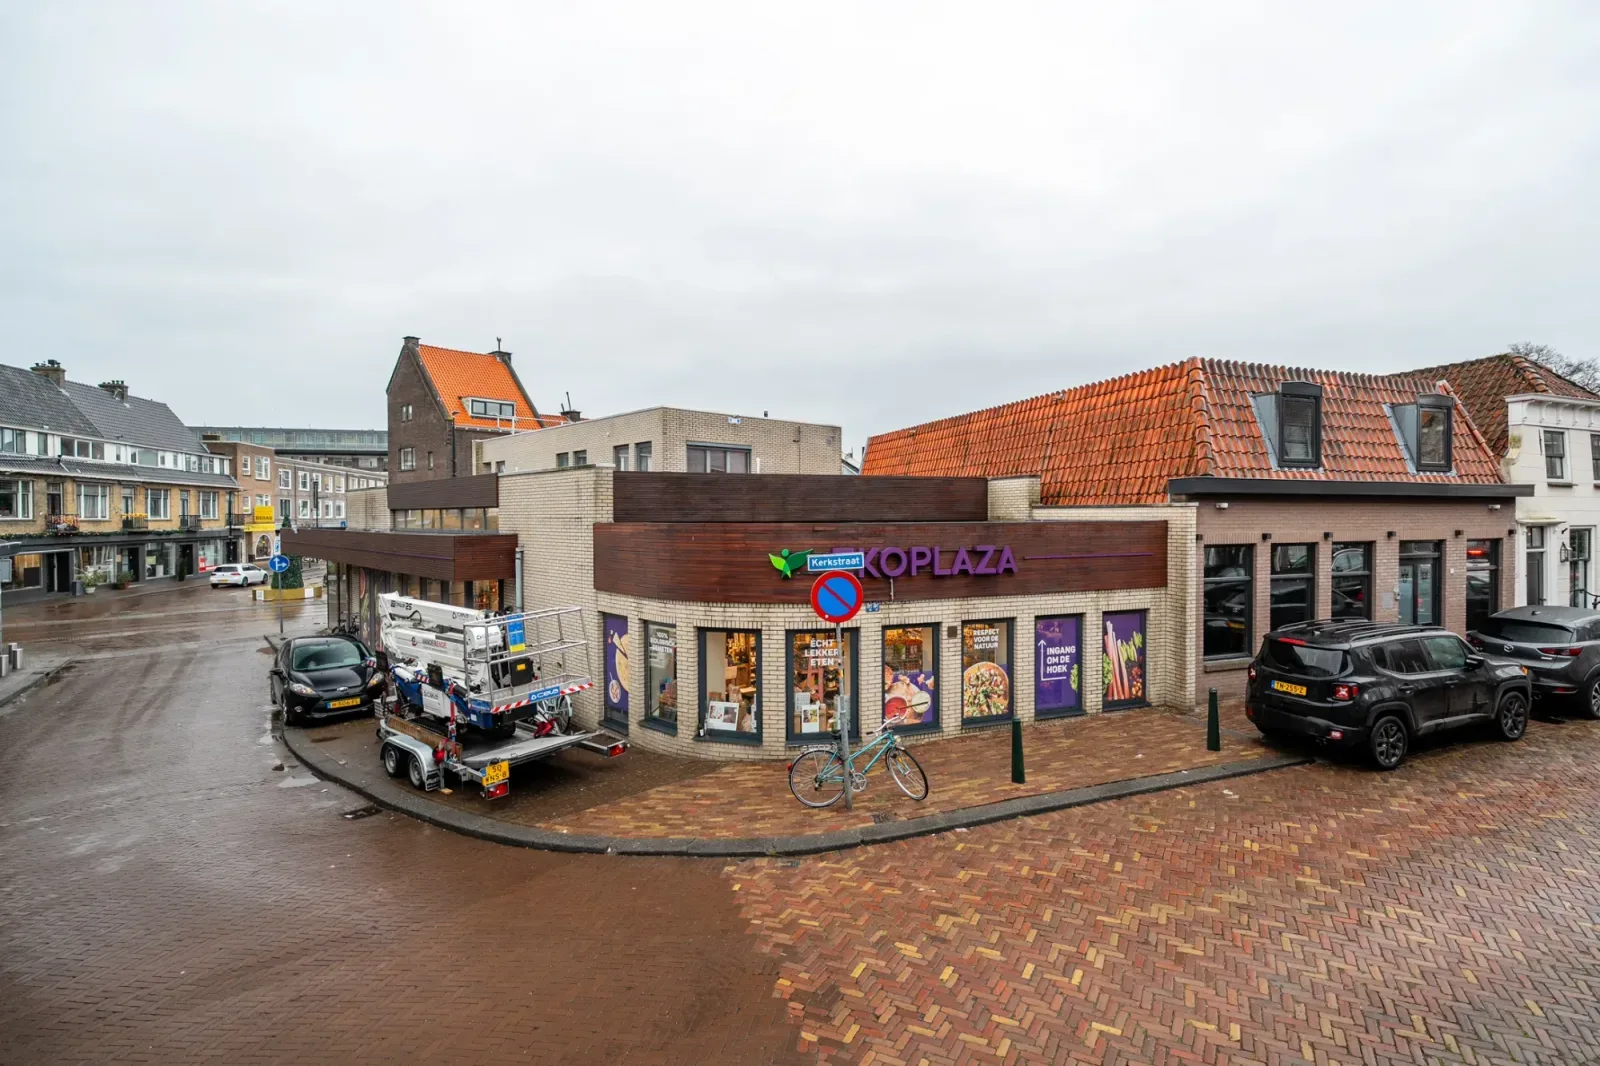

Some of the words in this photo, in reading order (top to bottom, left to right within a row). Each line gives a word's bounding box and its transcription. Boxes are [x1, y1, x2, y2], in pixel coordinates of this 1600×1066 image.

[811, 556, 860, 567] Kerkstraat
[832, 545, 1018, 578] KOPLAZA
[973, 628, 1000, 636] RESPECT
[974, 642, 999, 650] NATUUR
[1046, 646, 1076, 656] INGANG
[804, 649, 840, 657] LEKKER
[811, 658, 834, 666] ETEN
[1046, 656, 1059, 665] OM
[1060, 655, 1070, 664] DE
[1046, 664, 1068, 674] HOEK
